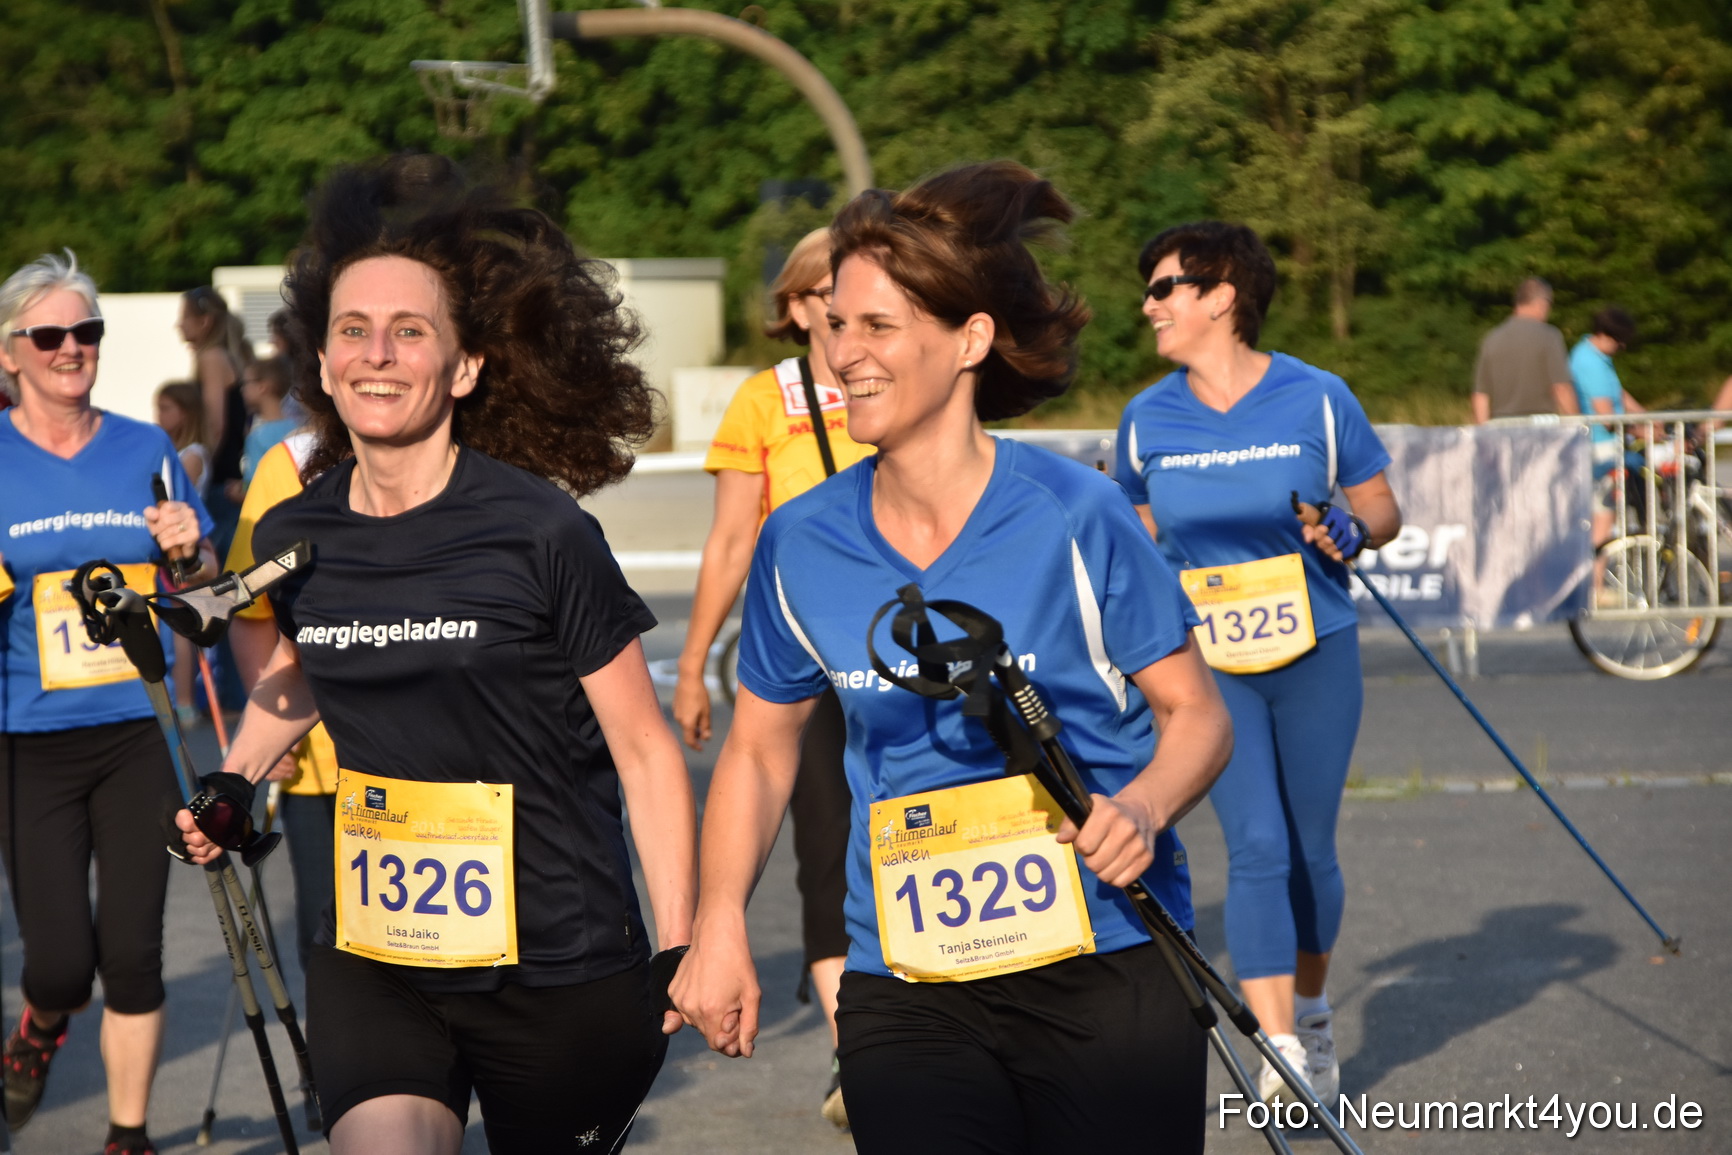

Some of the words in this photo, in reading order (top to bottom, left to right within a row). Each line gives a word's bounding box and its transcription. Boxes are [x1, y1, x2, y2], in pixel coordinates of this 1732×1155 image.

[1161, 442, 1301, 469] energiegeladen
[1357, 524, 1467, 570] er
[297, 617, 477, 649] energiegeladen
[1201, 601, 1298, 645] 1325
[830, 653, 1036, 691] energien
[356, 804, 409, 824] firmenlauf
[344, 823, 381, 841] walken
[411, 821, 445, 834] 2015
[895, 820, 957, 843] firmenlauf
[881, 849, 931, 867] walken
[351, 849, 492, 917] 1326
[895, 853, 1057, 933] 1329
[386, 925, 408, 938] Lisa
[409, 928, 440, 940] Jaiko
[938, 943, 972, 955] Tanja
[973, 931, 1028, 950] Steinlein
[387, 940, 420, 950] Seitz&Braun
[420, 943, 440, 951] GmbH
[955, 954, 994, 965] Seitz&Braun
[995, 949, 1015, 959] GmbH
